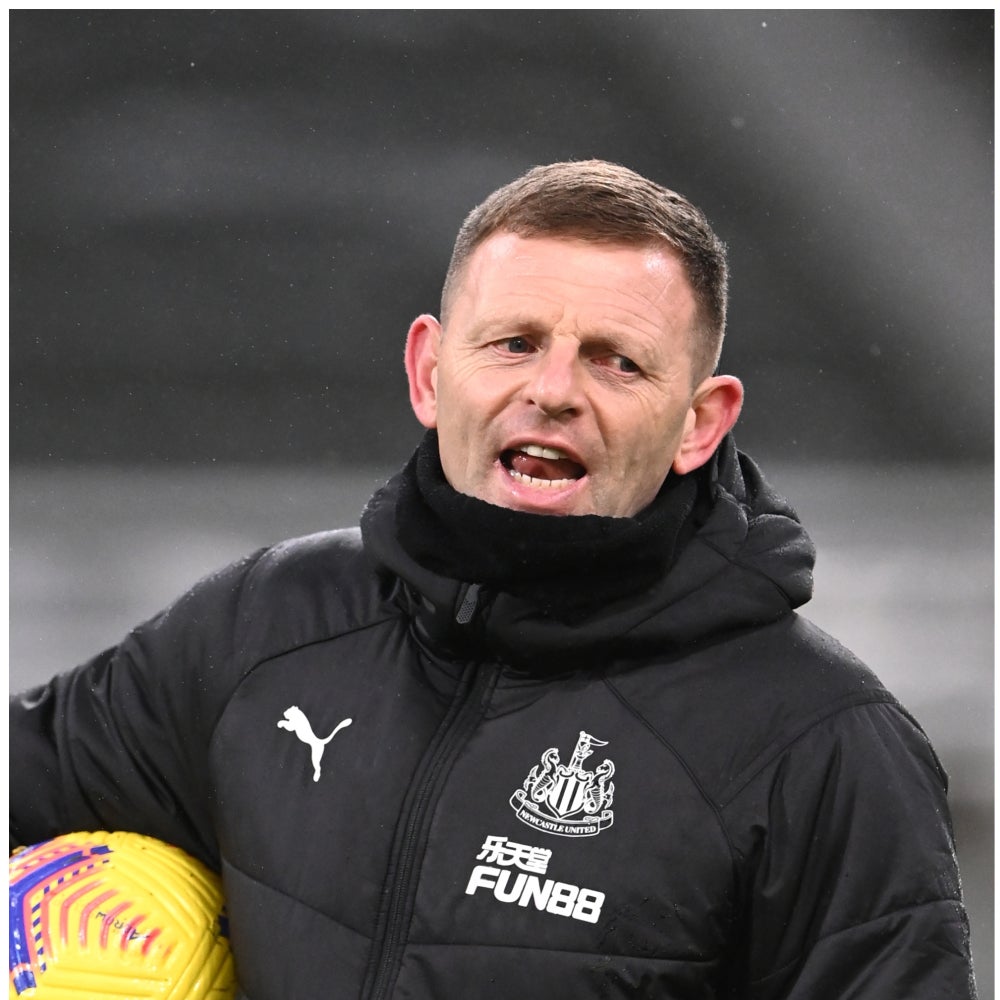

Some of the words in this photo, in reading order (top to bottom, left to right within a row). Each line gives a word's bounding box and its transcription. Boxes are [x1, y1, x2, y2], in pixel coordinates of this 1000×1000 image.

[520, 810, 564, 832] NEWCASTLE
[565, 825, 597, 834] UNITED
[476, 835, 552, 874] 乐天堂
[465, 865, 605, 923] FUN88
